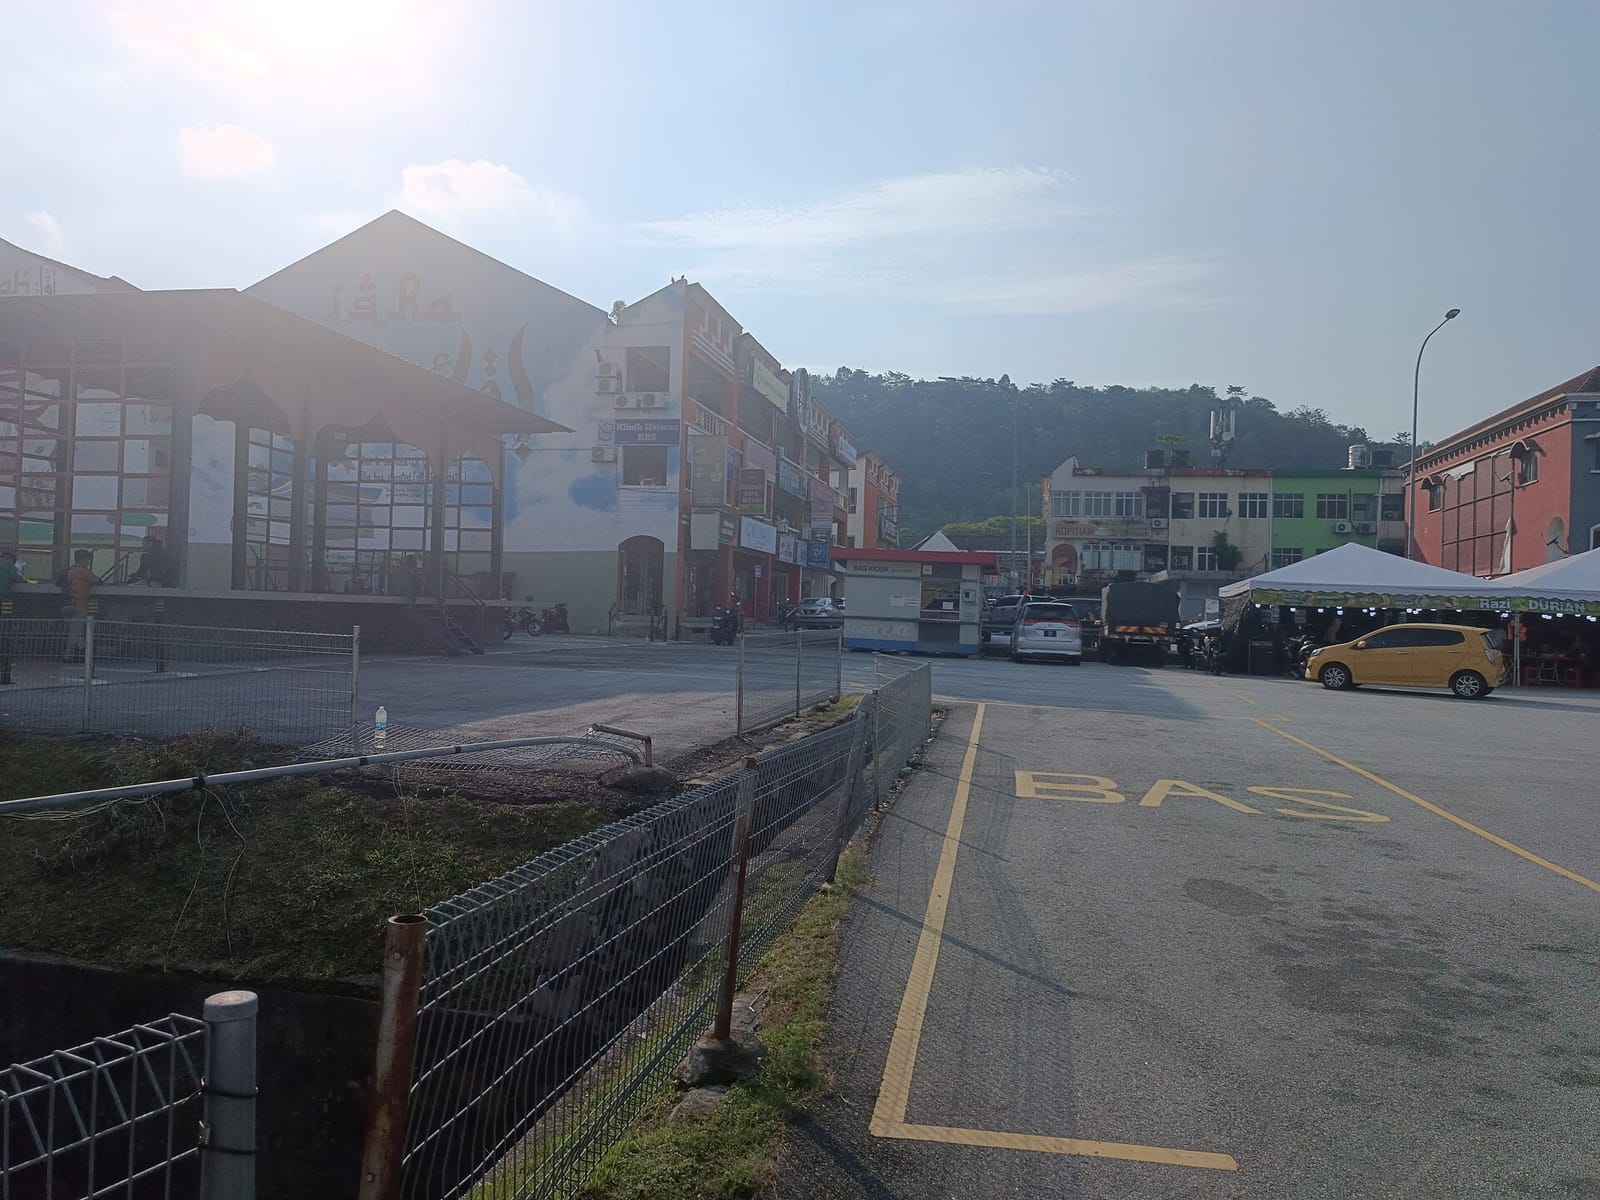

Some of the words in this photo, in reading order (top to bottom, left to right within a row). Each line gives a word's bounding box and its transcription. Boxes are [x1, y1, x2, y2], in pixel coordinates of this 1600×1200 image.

[616, 423, 643, 431] Klinik
[1055, 526, 1094, 536] KOPITIAM
[868, 565, 889, 573] KIOSK
[1479, 598, 1511, 609] Razi
[1014, 770, 1392, 823] BAS
